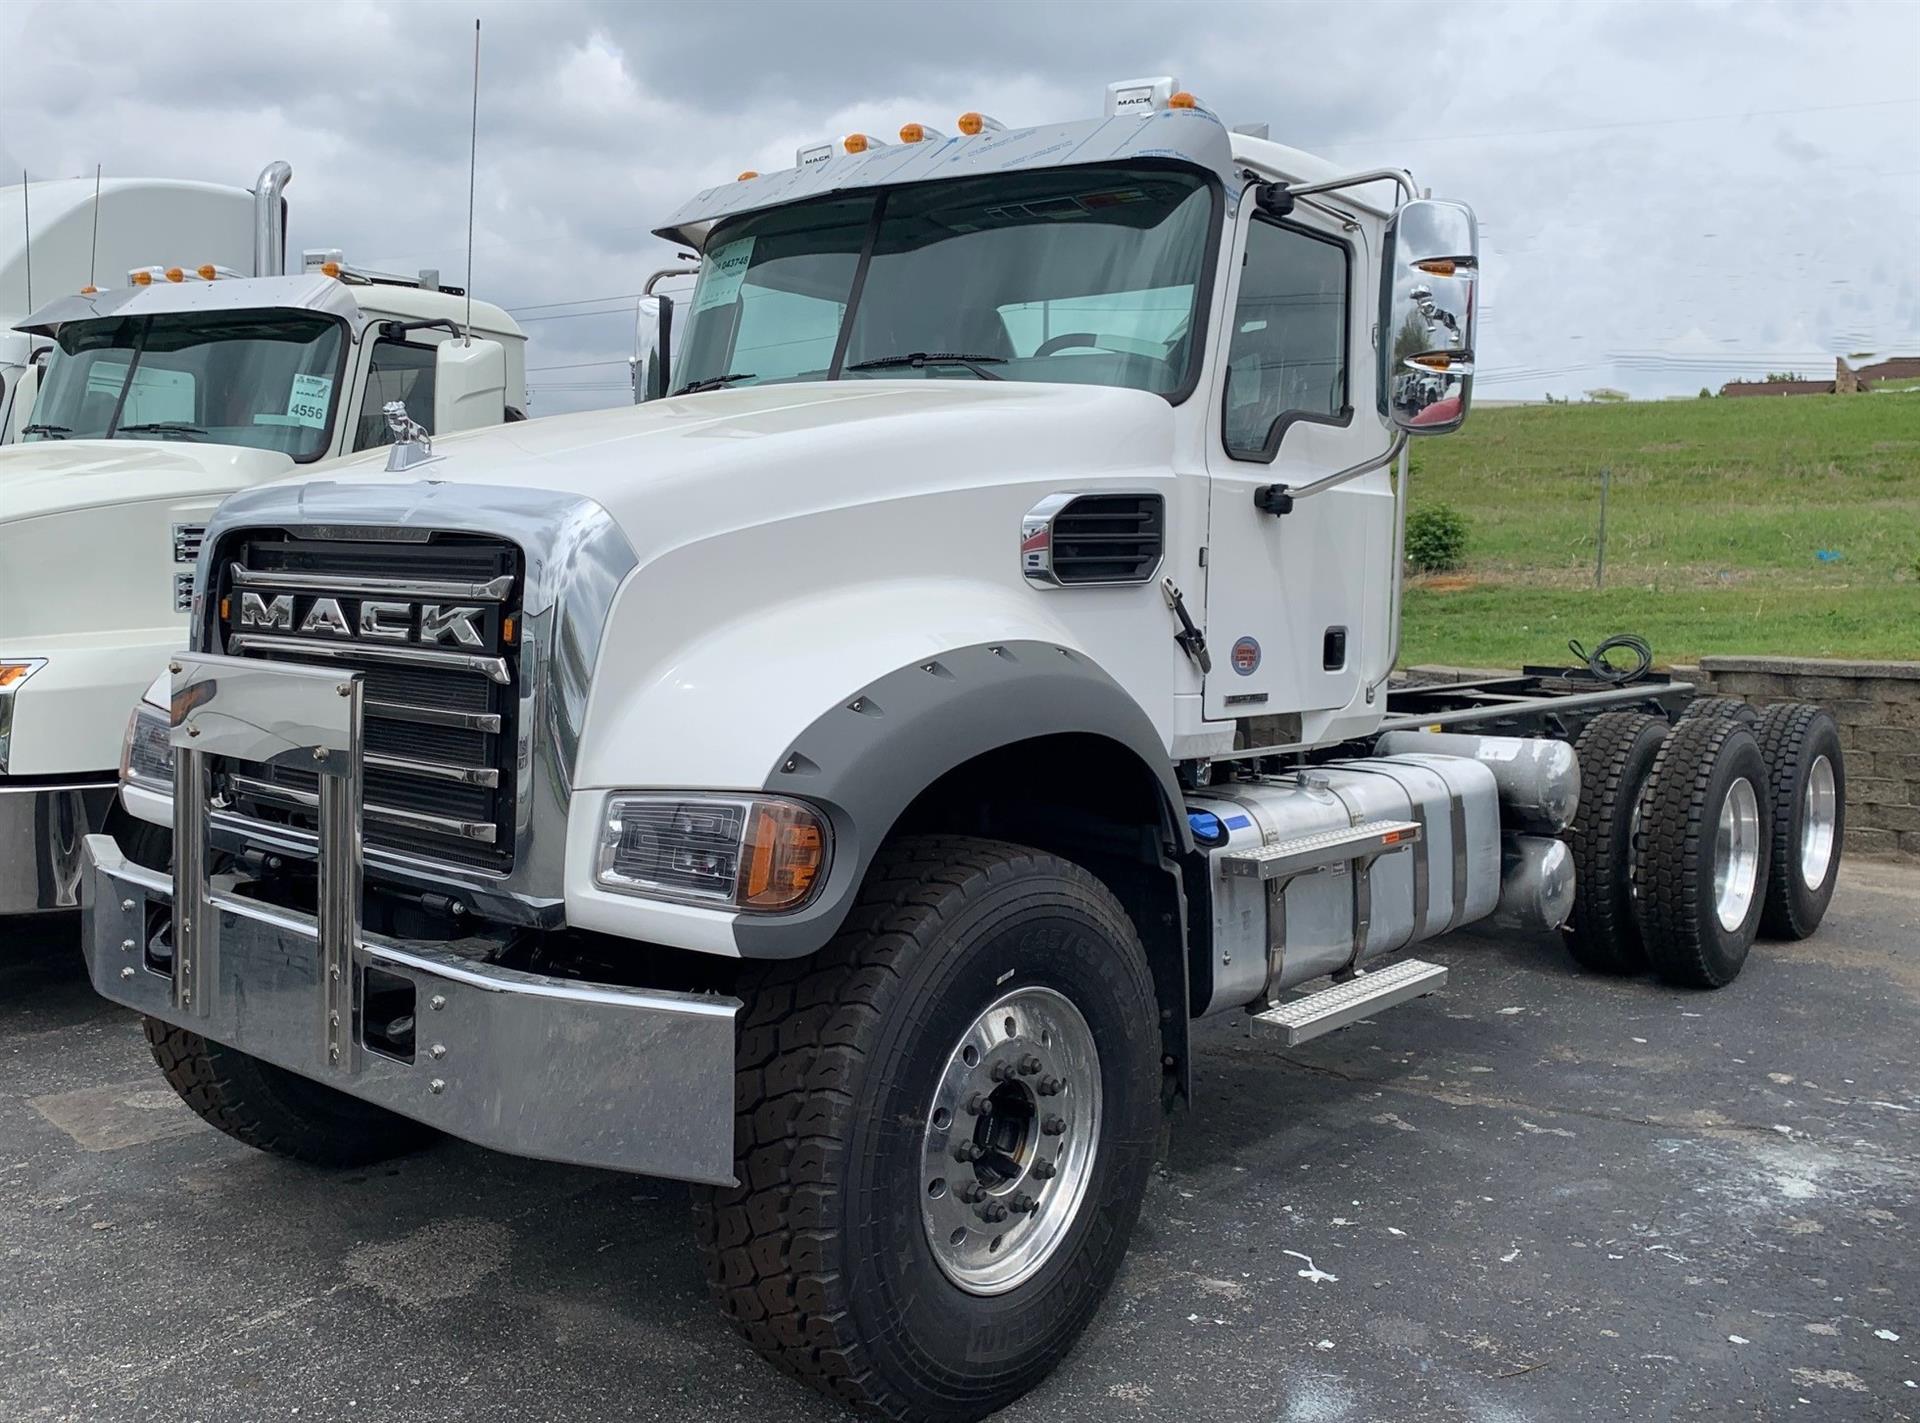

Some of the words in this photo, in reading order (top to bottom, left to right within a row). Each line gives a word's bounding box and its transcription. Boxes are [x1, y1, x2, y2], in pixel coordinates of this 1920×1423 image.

[1117, 97, 1152, 106] MACK
[804, 154, 830, 165] MACK
[291, 403, 323, 420] 4556
[240, 592, 486, 648] MACK
